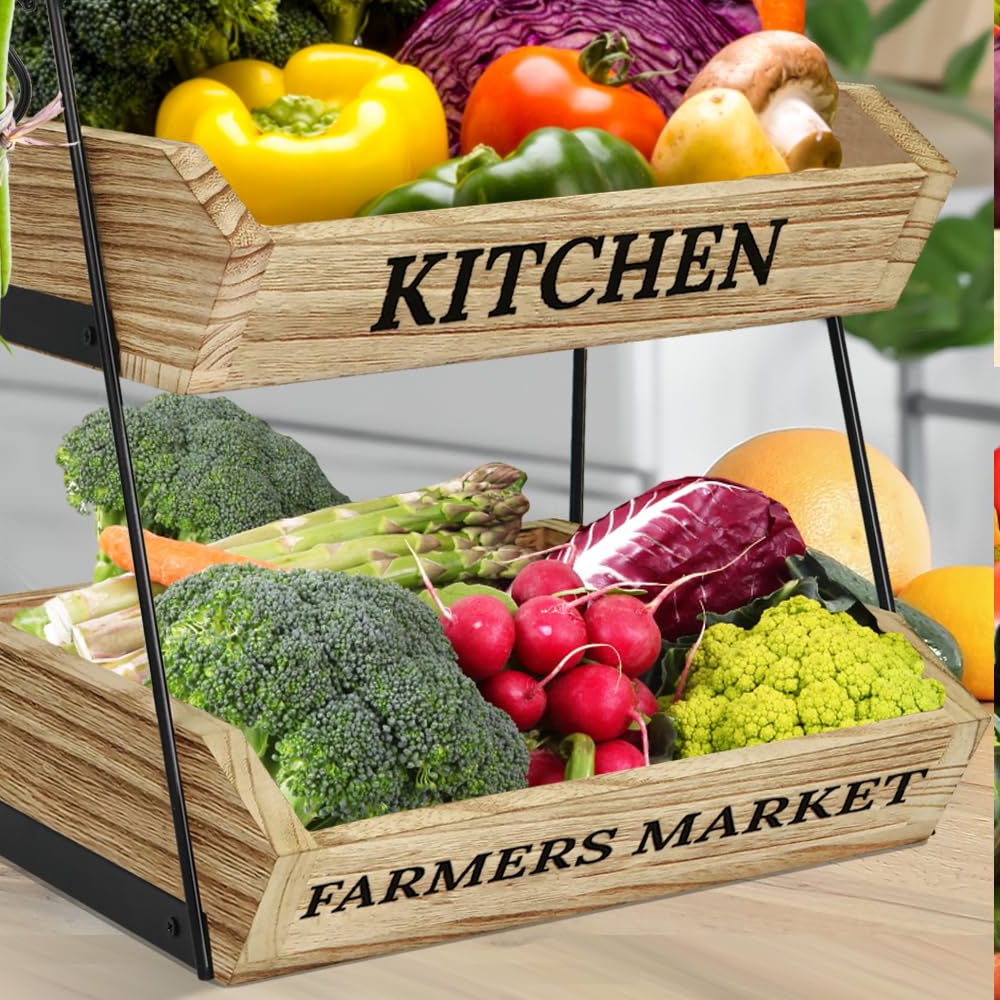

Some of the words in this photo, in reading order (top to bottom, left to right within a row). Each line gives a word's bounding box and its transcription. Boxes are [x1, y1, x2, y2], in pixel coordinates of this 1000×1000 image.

[370, 218, 788, 332] KITCHEN
[300, 828, 618, 919] FARMERS
[631, 769, 929, 856] MARKET
